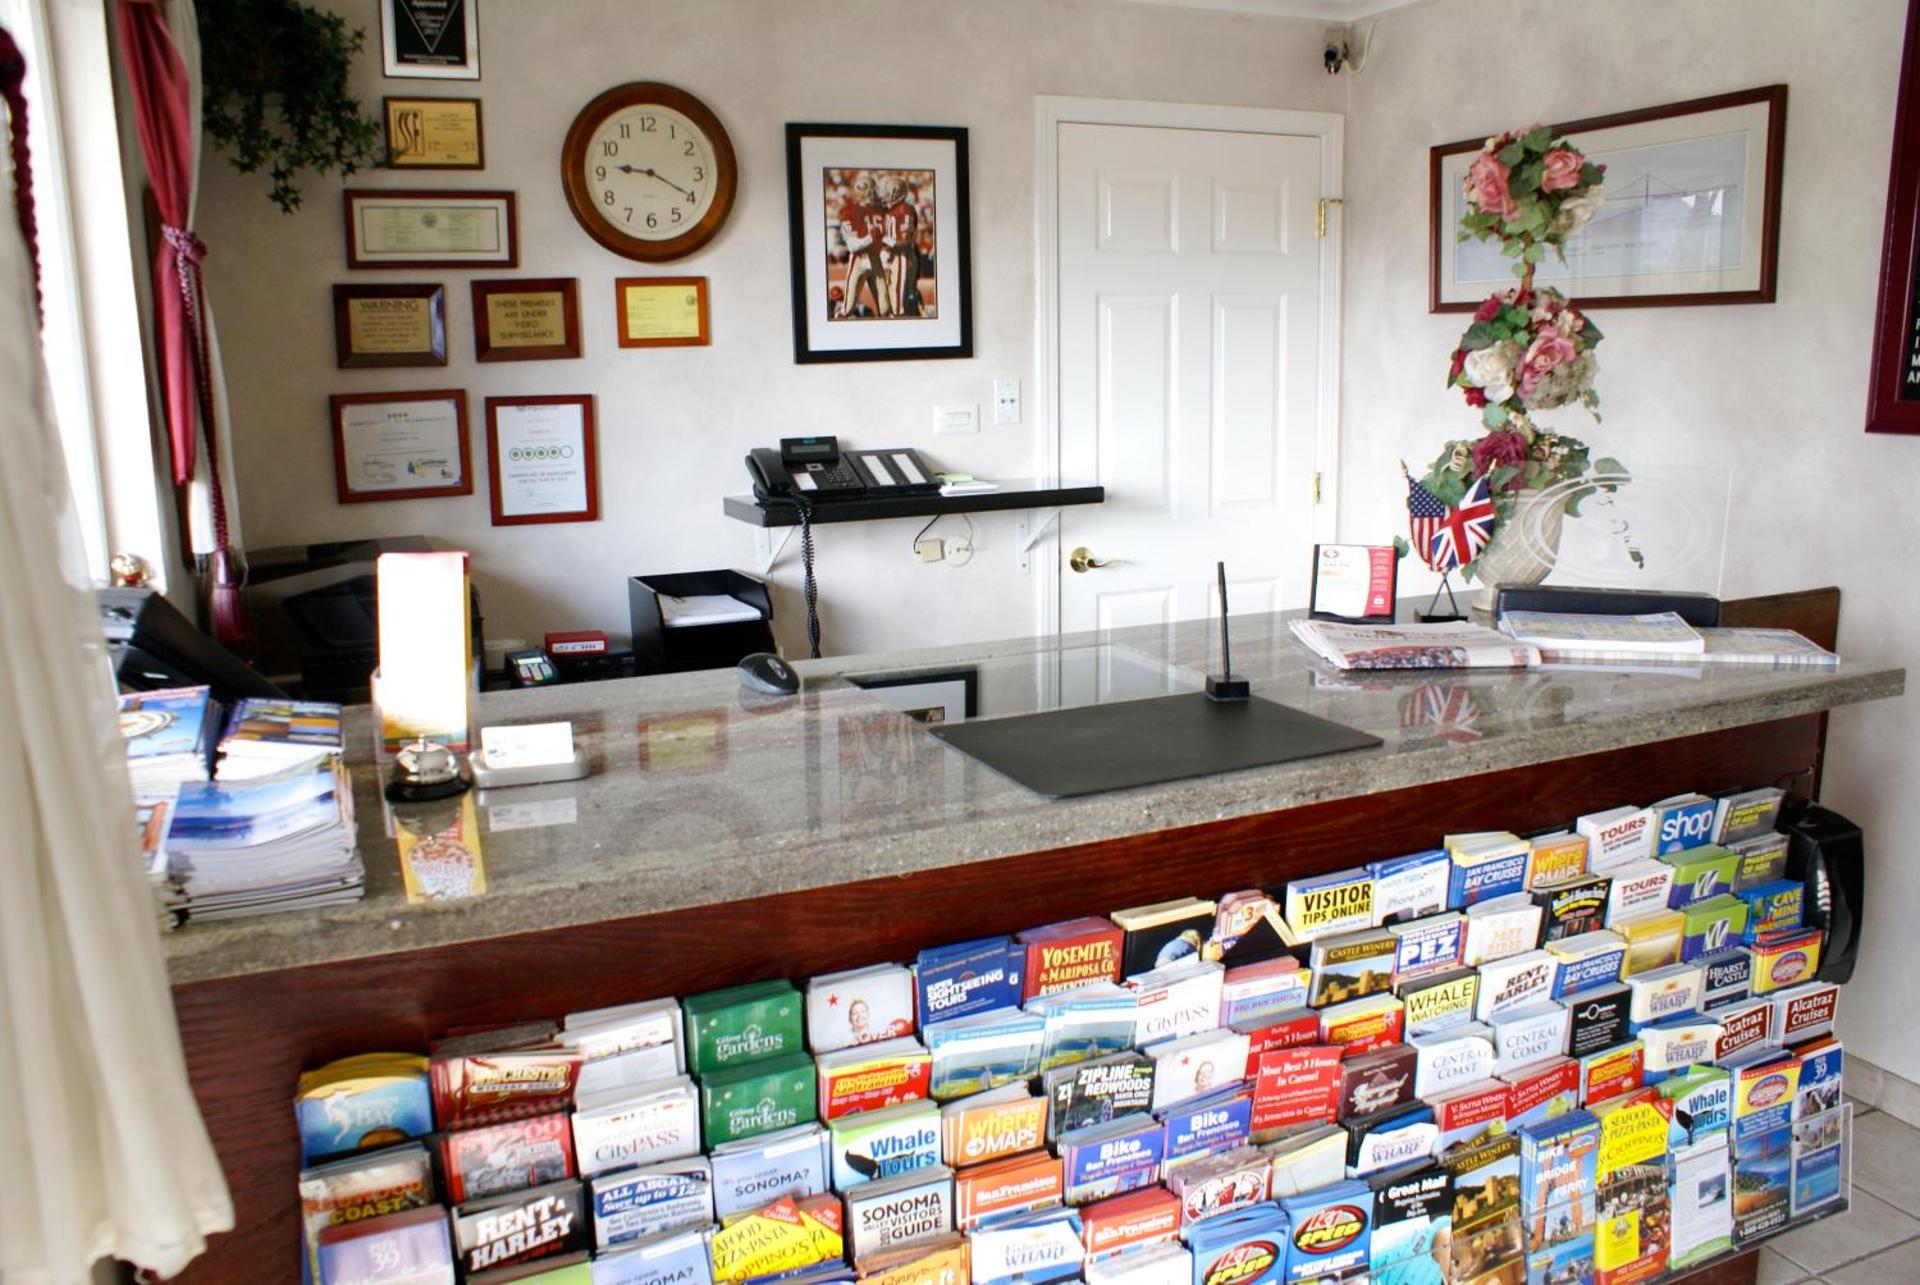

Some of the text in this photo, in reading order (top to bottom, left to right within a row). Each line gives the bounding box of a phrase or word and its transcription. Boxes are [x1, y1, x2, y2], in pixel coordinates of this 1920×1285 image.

[620, 123, 630, 139] 11
[640, 116, 657, 132] 12
[671, 124, 676, 139] 1
[603, 141, 618, 157] 10
[684, 141, 695, 156] 2
[595, 166, 606, 181] 9
[693, 166, 703, 182] 3
[604, 190, 615, 205] 8
[686, 190, 696, 205] 4
[624, 207, 633, 222] 7
[646, 213, 657, 228] 6
[671, 207, 681, 223] 5
[1600, 817, 1647, 841] TOURS
[1661, 810, 1713, 841] shop
[1535, 849, 1583, 873] where
[1464, 866, 1523, 889] BAY CRUISES
[1621, 874, 1668, 895] TOURS
[1304, 883, 1371, 912] VISITOR
[1773, 888, 1802, 907] CAVE
[1303, 901, 1371, 925] TIPS ONLINE
[1042, 940, 1112, 968] YOSEMITE
[1329, 939, 1396, 959] CASTLE WINERY
[1400, 936, 1457, 967] PEZ
[1049, 963, 1099, 983] MARIPOSA
[1506, 963, 1544, 989] RENT
[1564, 971, 1582, 984] BAY
[1709, 961, 1746, 980] HEARST
[1714, 969, 1748, 988] CASTLE
[927, 967, 1004, 1000] SIGHTSEEING
[1494, 973, 1549, 1005] HARLEY
[927, 992, 967, 1012] TOURS
[1410, 981, 1472, 1012] WHALE
[1650, 994, 1690, 1013] WHARF
[1791, 993, 1834, 1013] Alcatraz
[1411, 998, 1468, 1022] WATCHING
[1791, 1007, 1829, 1025] Cruises
[1721, 1011, 1763, 1037] Alcatraz
[1506, 1024, 1558, 1048] CENTRAL
[1721, 1025, 1760, 1050] Cruises
[717, 1033, 784, 1061] gardens
[1511, 1041, 1550, 1060] COAST
[1665, 1045, 1706, 1063] WHARF
[1261, 1066, 1282, 1076] Your
[1283, 1063, 1302, 1073] Best
[1310, 1058, 1338, 1068] Hours
[1432, 1050, 1489, 1069] CENTRAL
[1078, 1064, 1135, 1085] ZIPLINE
[1288, 1070, 1319, 1084] Carmel
[1437, 1063, 1477, 1080] COAST
[1814, 1063, 1827, 1080] 39
[1084, 1077, 1151, 1097] REDWOODS
[1689, 1089, 1727, 1114] Whale
[729, 1107, 797, 1136] gardens
[968, 1110, 1039, 1138] where
[1190, 1110, 1229, 1132] Bike
[985, 1126, 1037, 1154] MAPS
[1177, 1133, 1195, 1144] San
[1196, 1120, 1240, 1139] Francisco
[595, 1128, 680, 1162] CityPASS
[870, 1129, 936, 1158] Whale
[1100, 1139, 1142, 1160] Bike
[1372, 1142, 1419, 1163] WHARF
[1479, 1142, 1512, 1161] WINERY
[1537, 1145, 1565, 1162] BIKE
[879, 1149, 937, 1177] Tours
[1085, 1162, 1104, 1172] San
[1105, 1149, 1152, 1167] Francisco
[735, 1168, 810, 1197] SONOMA?
[1536, 1160, 1577, 1185] BRIDGE
[602, 1184, 633, 1204] ALL
[634, 1194, 651, 1206] up
[653, 1188, 667, 1200] to
[1388, 1181, 1420, 1200] Great
[1421, 1175, 1448, 1192] Mall
[330, 1198, 404, 1225] COAST
[862, 1192, 941, 1224] SONOMA
[890, 1206, 943, 1227] VISITORS
[477, 1196, 555, 1246] RENT
[891, 1217, 943, 1240] GUIDE
[471, 1212, 574, 1271] HARLEY
[1297, 1221, 1362, 1248] SPEED
[370, 1249, 400, 1274] 39
[1207, 1254, 1274, 1285] SPEED
